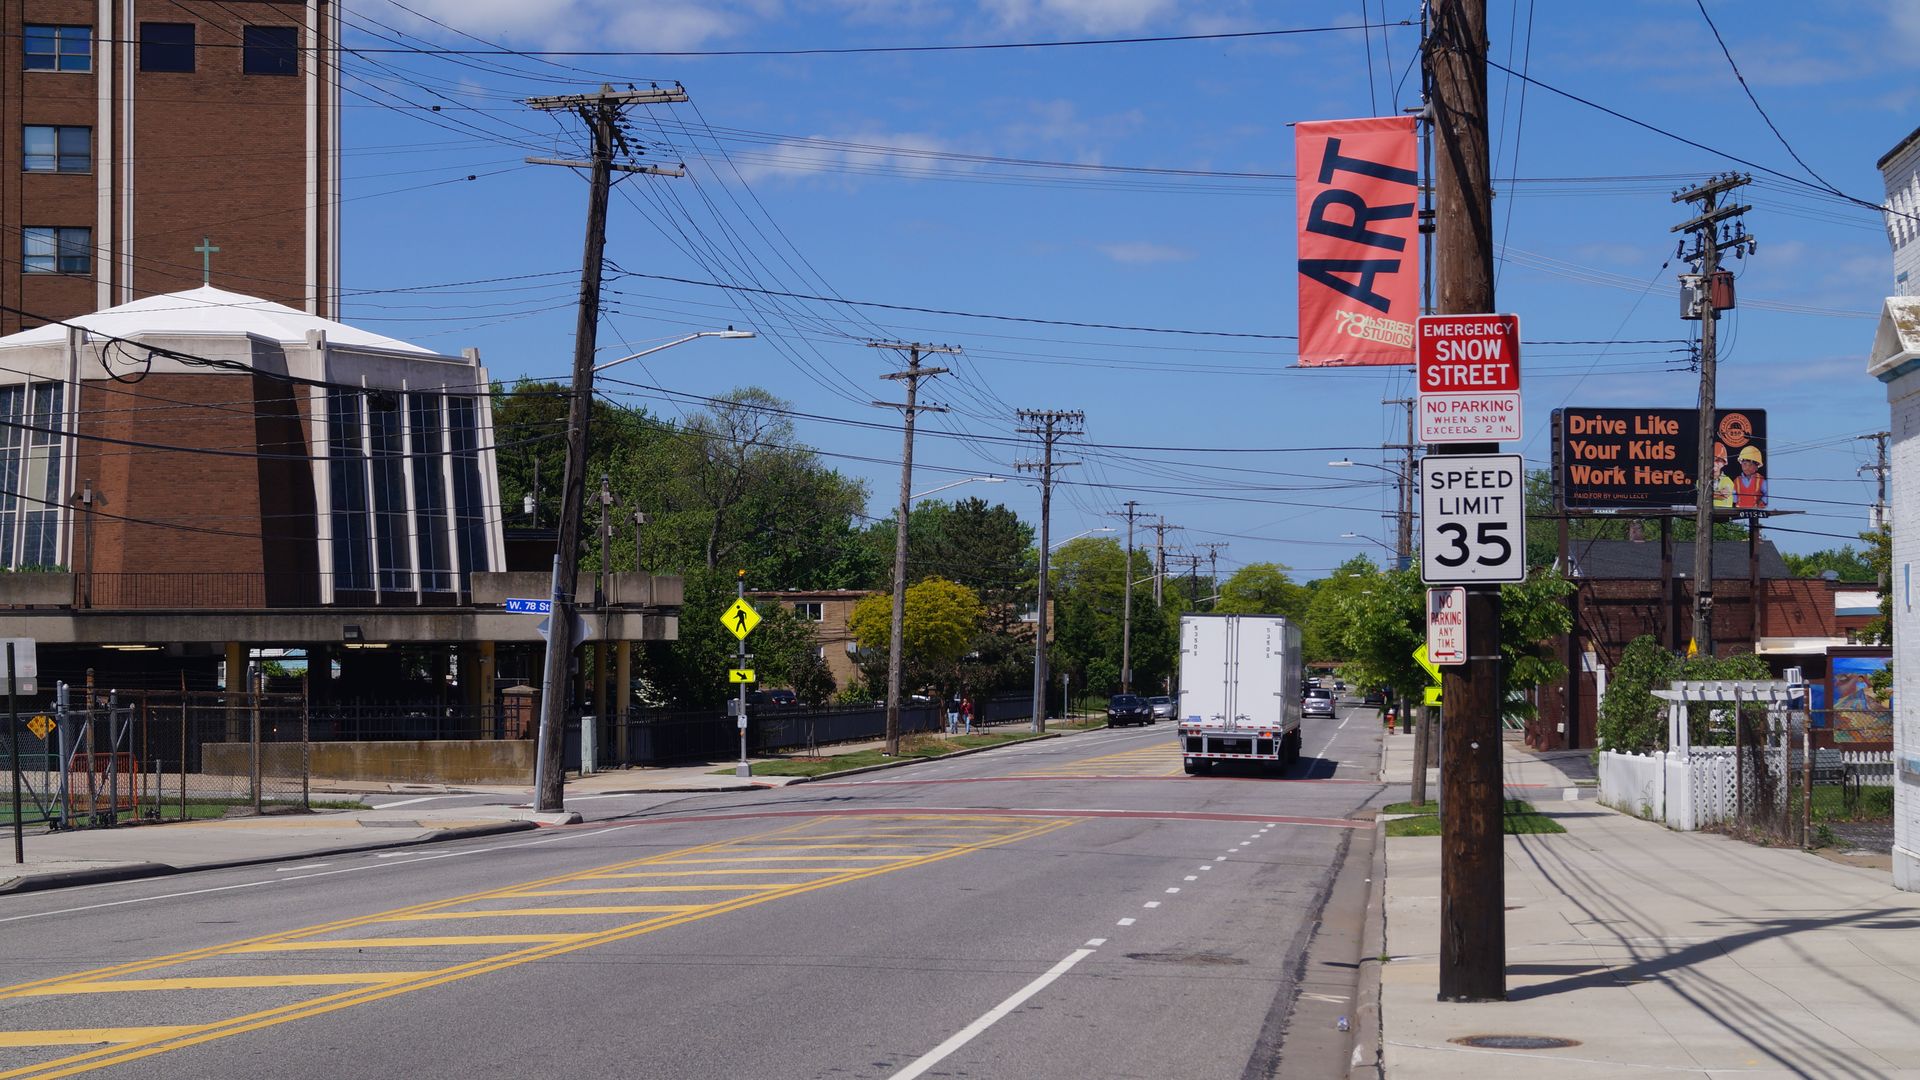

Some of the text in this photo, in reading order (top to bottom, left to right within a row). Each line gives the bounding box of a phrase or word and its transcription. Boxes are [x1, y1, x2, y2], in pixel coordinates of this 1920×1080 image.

[1298, 137, 1417, 313] ART
[1376, 318, 1415, 335] STREET
[1424, 323, 1513, 337] EMERGENCY
[1362, 326, 1411, 346] STUDIOS
[1436, 339, 1502, 361] SNOW
[1427, 364, 1510, 386] STREET
[1427, 400, 1513, 413] NO PARKING
[1427, 425, 1515, 434] EXCEEDS 2 IN.
[1570, 415, 1679, 434] Drive Like
[1570, 440, 1676, 459] Your Kids
[1431, 471, 1513, 489] SPEED
[1570, 465, 1691, 485] Work Here.
[1439, 497, 1504, 515] LIMIT
[1435, 522, 1511, 567] 35
[509, 600, 549, 611] W. 78 St
[1439, 595, 1452, 608] NO
[1431, 612, 1461, 625] PARKING
[1439, 627, 1453, 636] ANY
[1438, 639, 1454, 648] TIME
